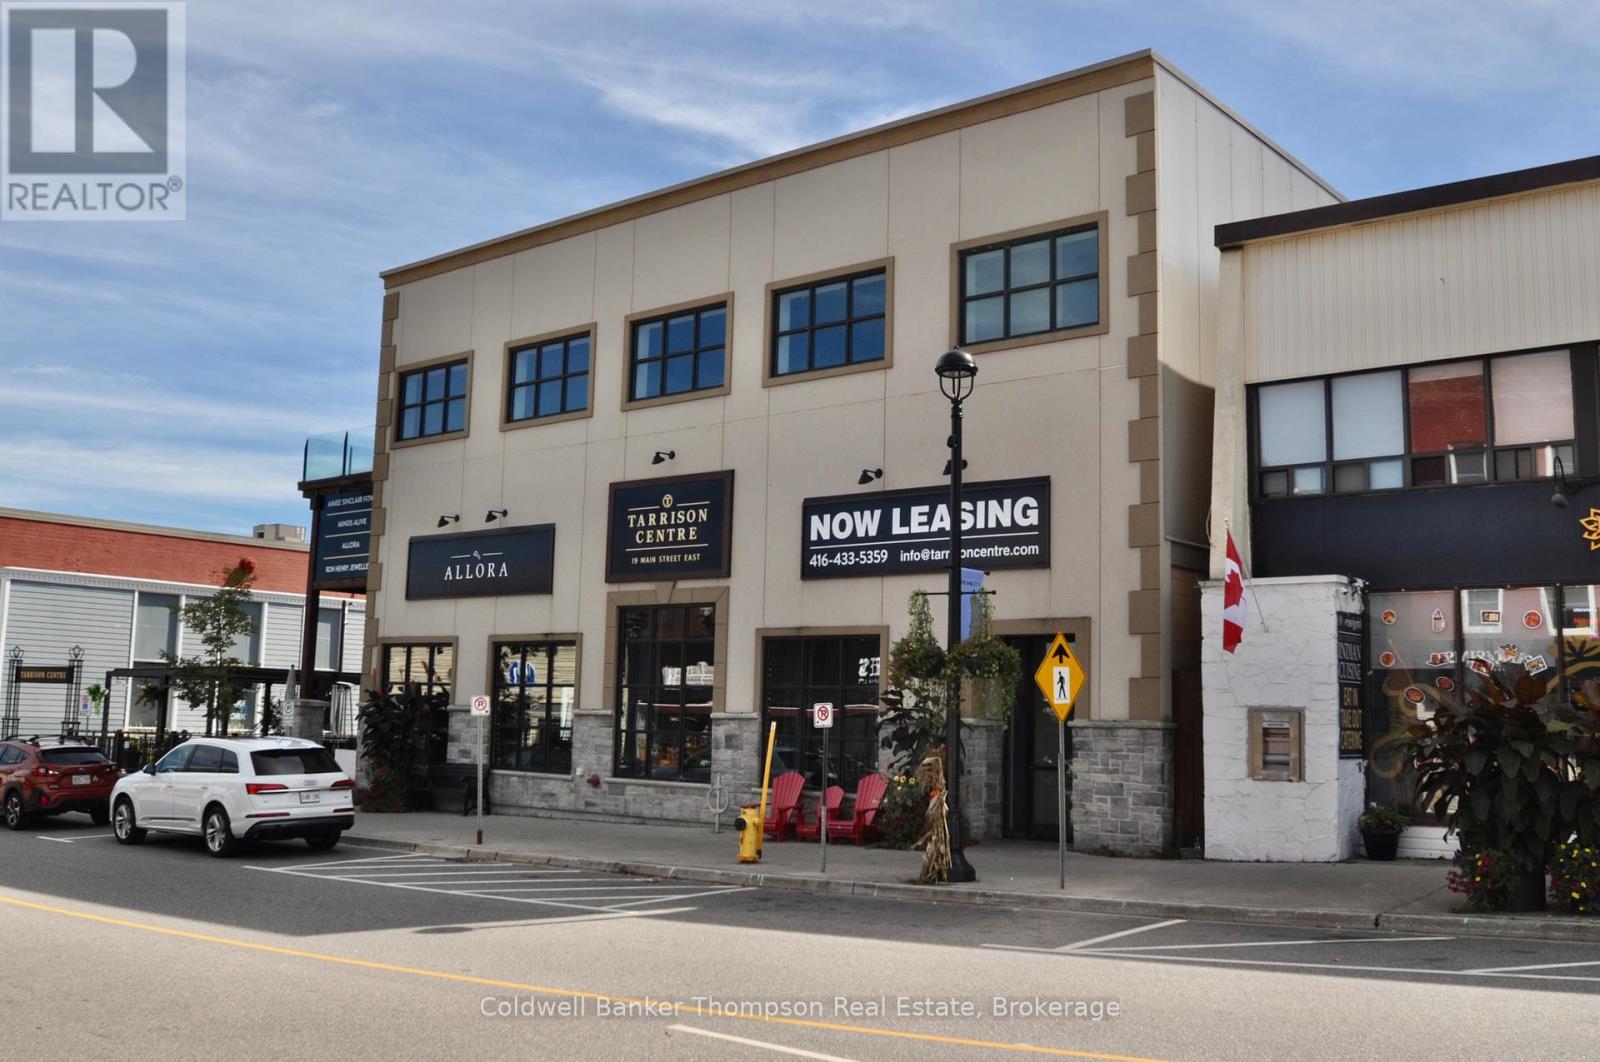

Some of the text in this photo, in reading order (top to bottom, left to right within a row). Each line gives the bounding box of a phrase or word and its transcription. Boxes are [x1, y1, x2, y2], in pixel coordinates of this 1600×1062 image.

[627, 508, 708, 528] TARRISON
[810, 496, 1039, 541] NOW LEASING
[635, 527, 698, 544] CENTRE
[342, 541, 360, 549] ALLORA
[631, 553, 701, 565] 19 MAIN STREET EAST
[809, 545, 1040, 567] 416-433-5359 info@tarroncentre.com
[444, 562, 508, 580] ALLORA
